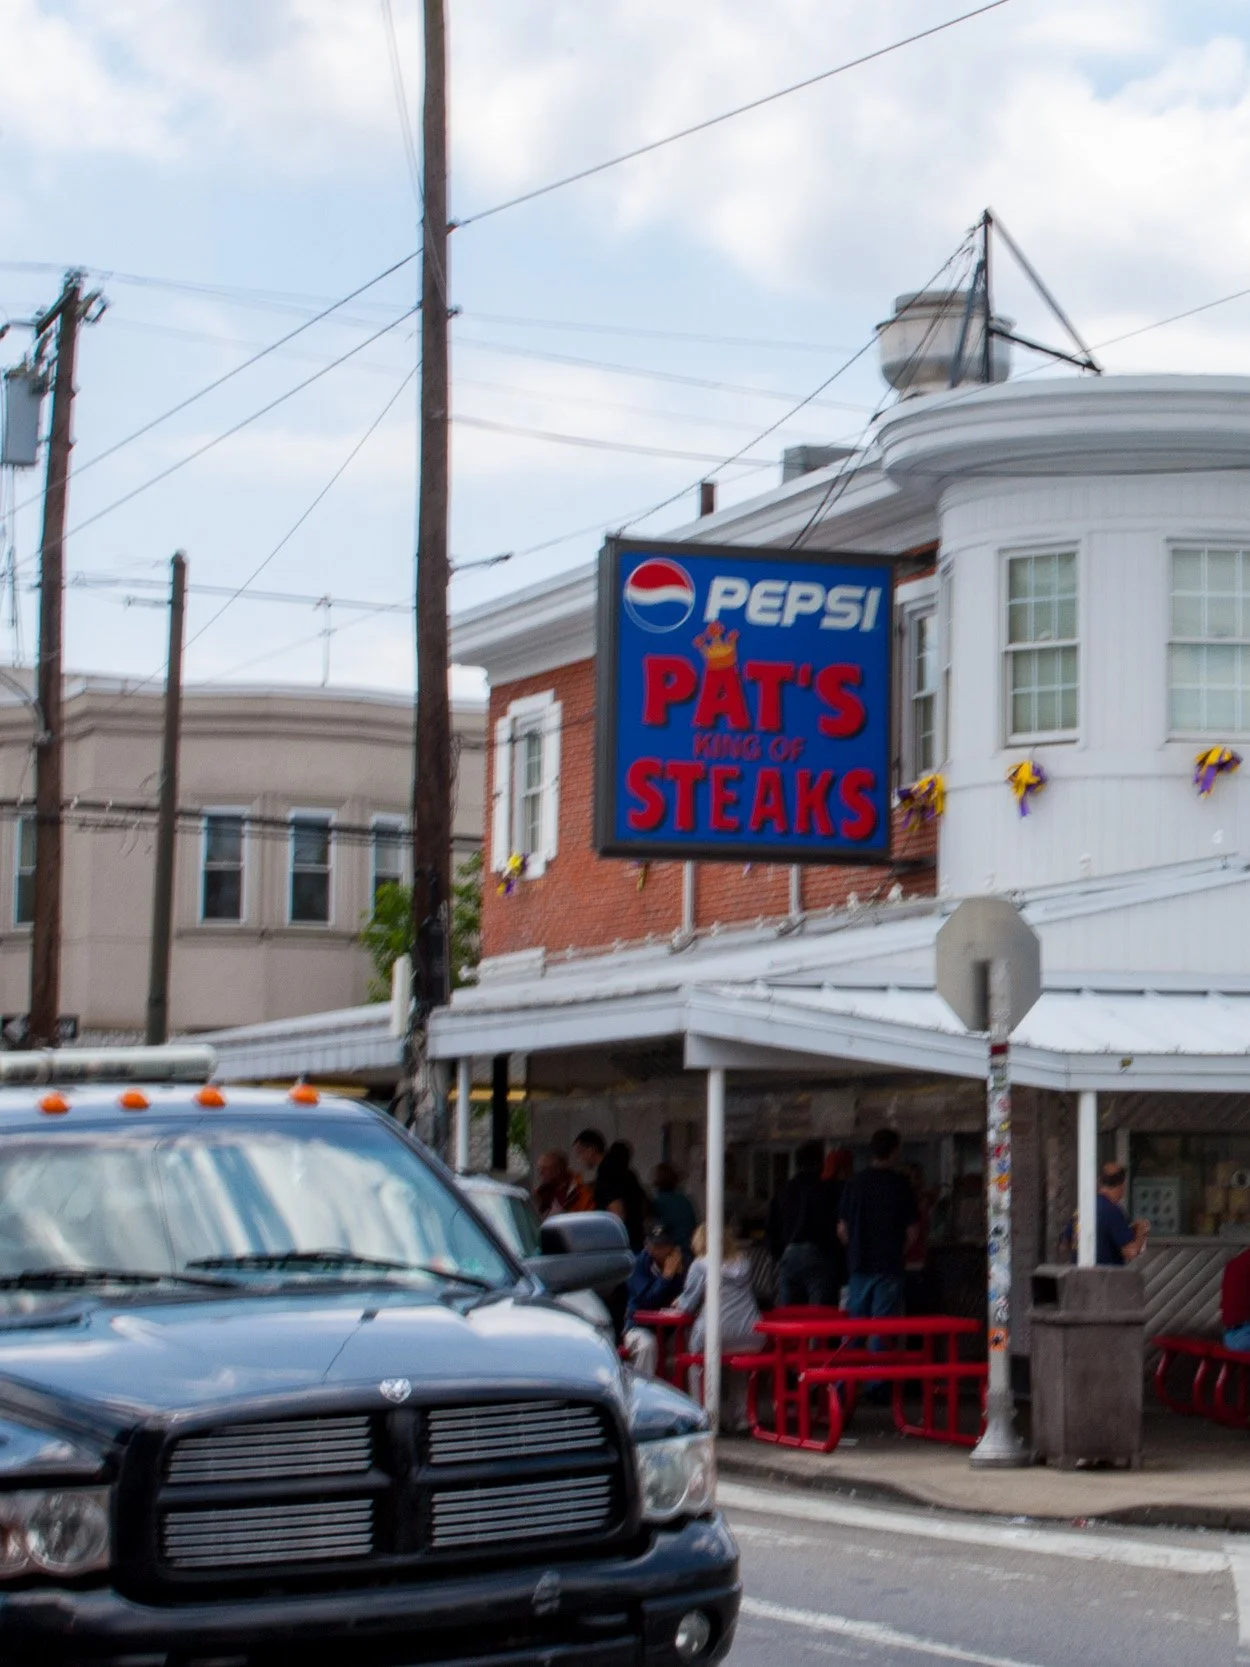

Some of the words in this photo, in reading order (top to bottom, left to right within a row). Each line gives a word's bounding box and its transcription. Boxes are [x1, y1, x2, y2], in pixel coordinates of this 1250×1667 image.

[702, 575, 883, 632] PEPSI
[640, 652, 867, 740] PAT'S
[692, 732, 763, 762] KING
[769, 737, 806, 763] OF
[625, 756, 879, 842] STEAKS
